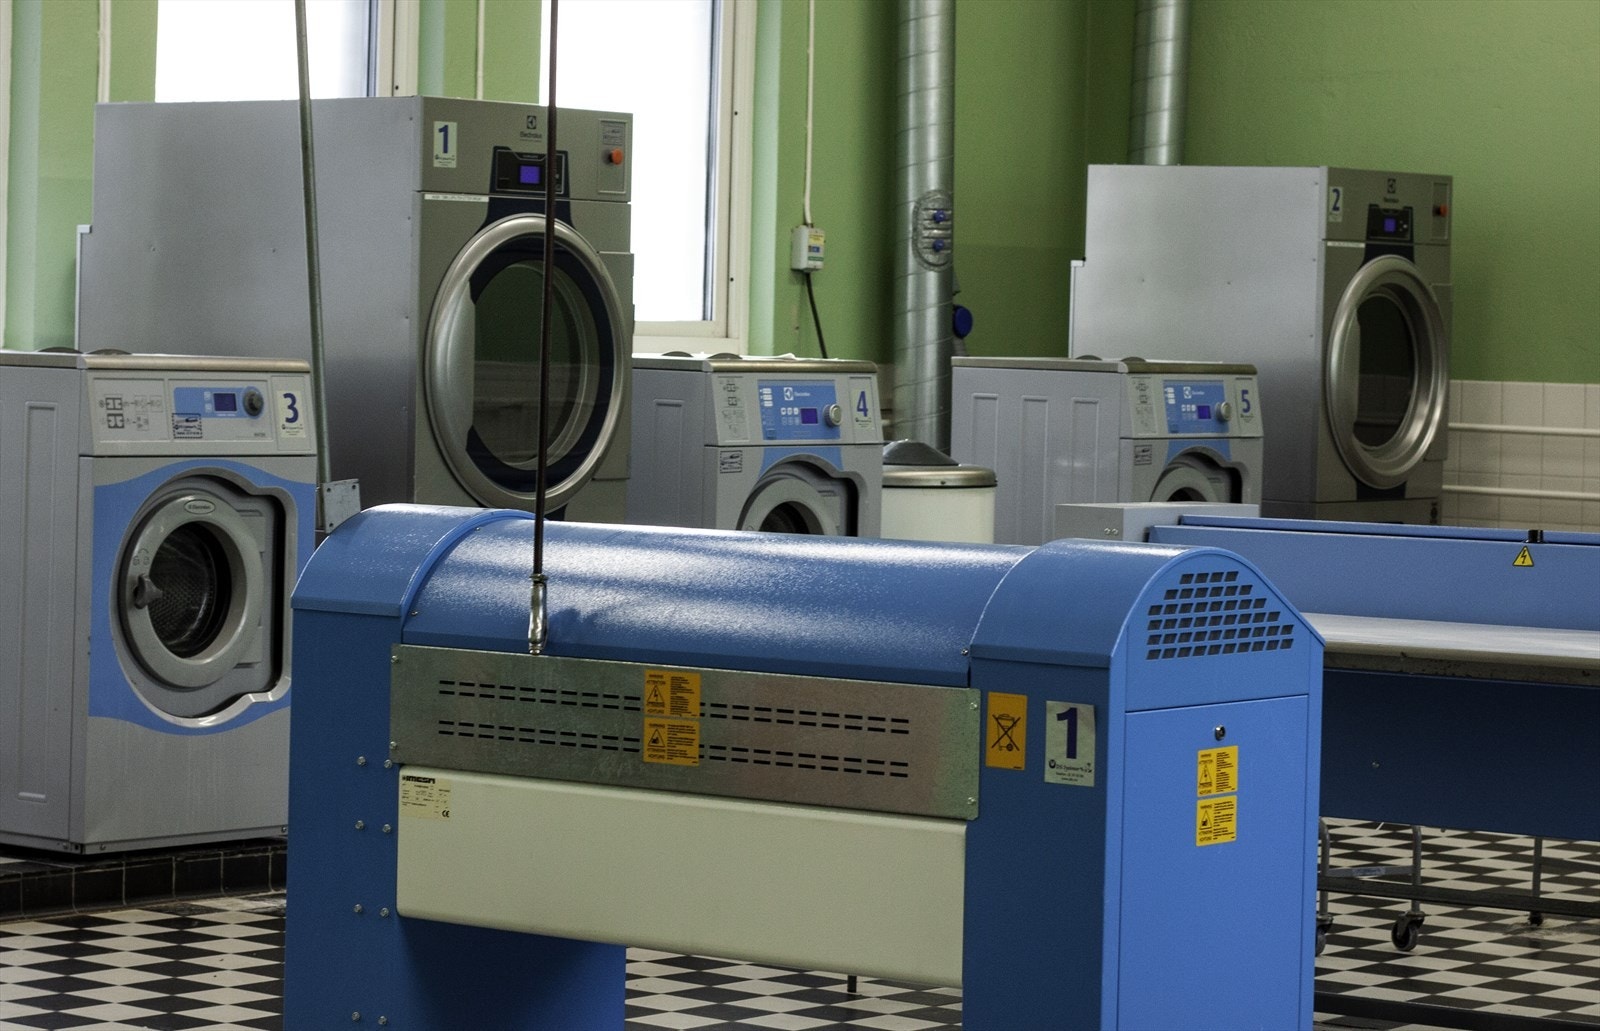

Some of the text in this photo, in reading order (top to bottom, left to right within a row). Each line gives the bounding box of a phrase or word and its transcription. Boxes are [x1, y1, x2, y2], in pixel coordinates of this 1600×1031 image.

[438, 124, 449, 154] 1
[1332, 188, 1340, 212] 2
[283, 392, 299, 424] 3
[857, 390, 869, 417] 4
[1241, 389, 1251, 413] 5
[1056, 707, 1078, 759] 1
